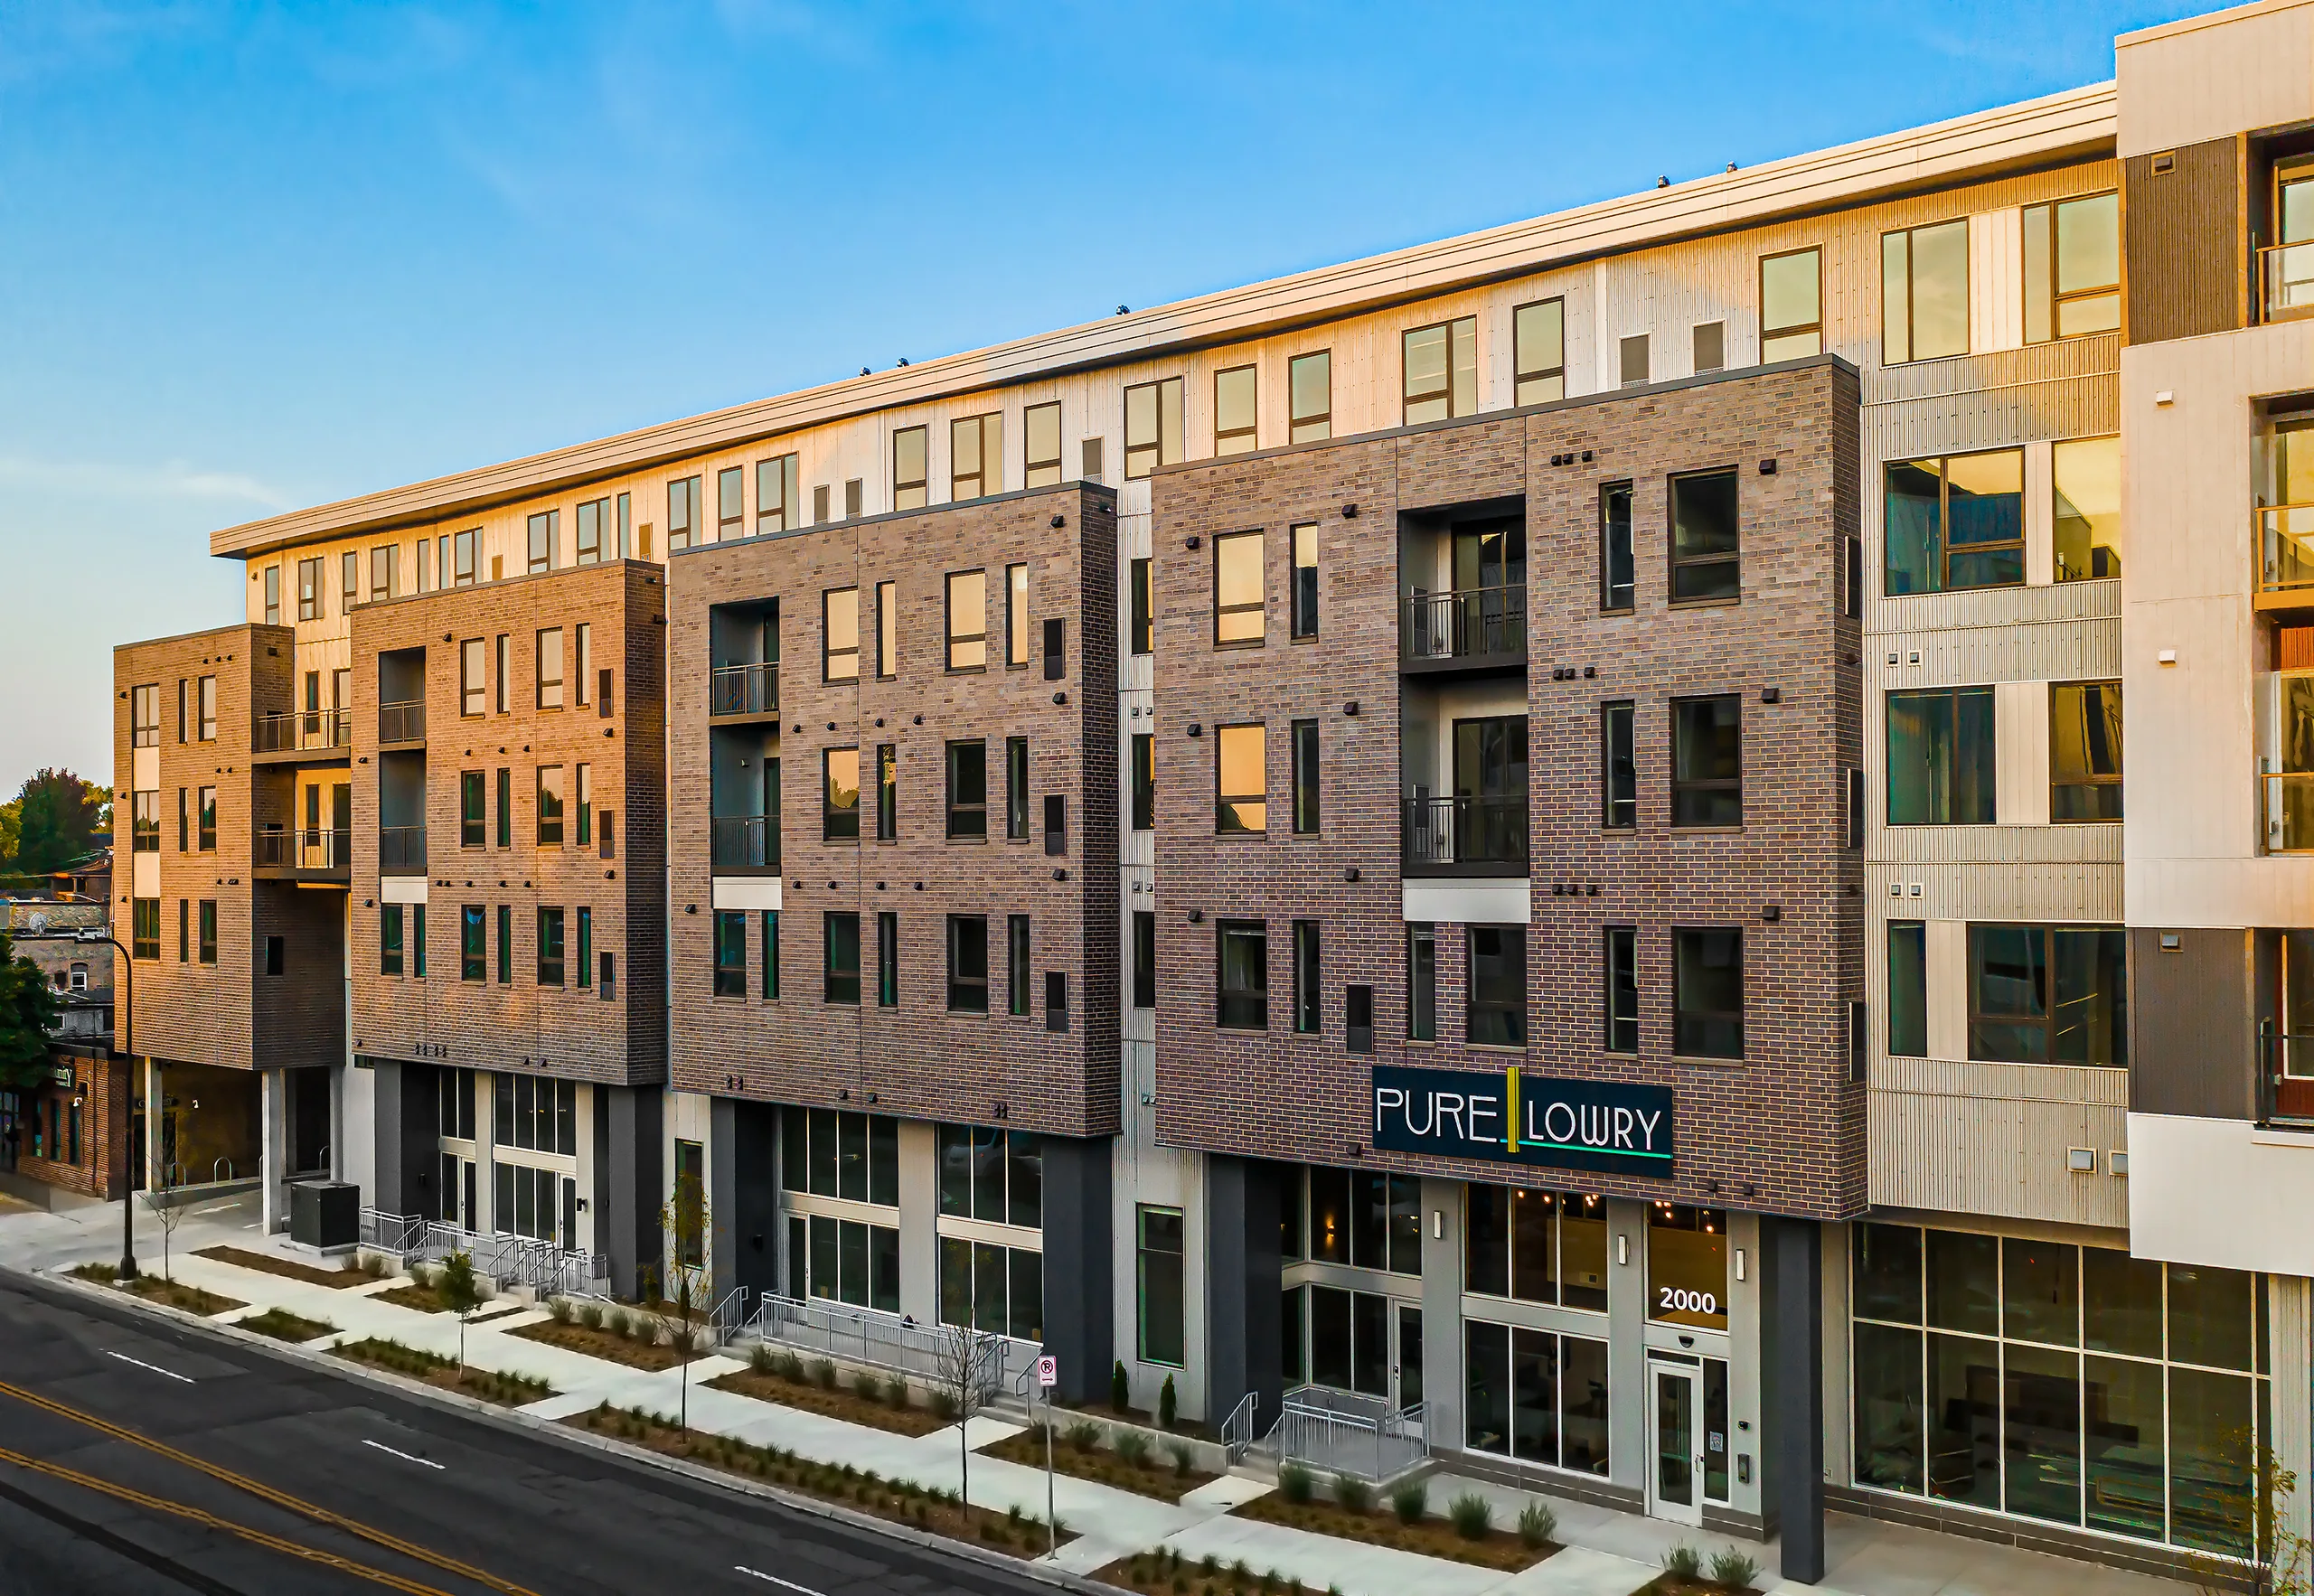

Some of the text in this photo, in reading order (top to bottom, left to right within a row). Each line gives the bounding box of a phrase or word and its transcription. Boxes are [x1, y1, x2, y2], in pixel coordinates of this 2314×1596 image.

[1377, 1087, 1661, 1150] PURE LOWRY
[1660, 1286, 1717, 1315] 2000
